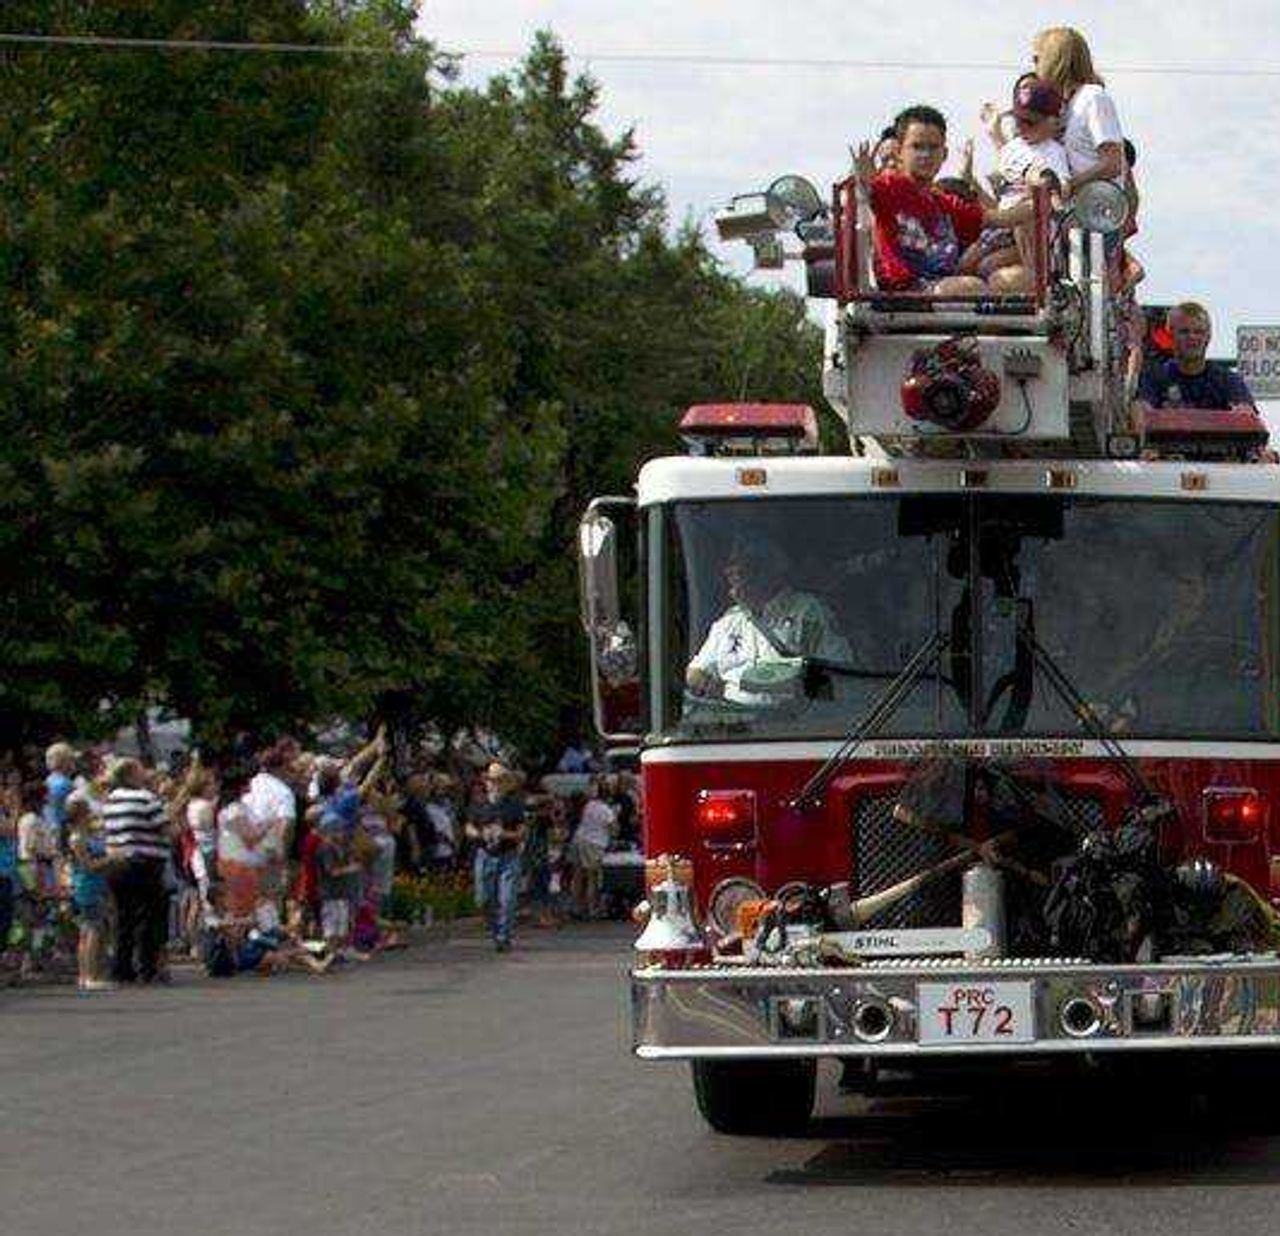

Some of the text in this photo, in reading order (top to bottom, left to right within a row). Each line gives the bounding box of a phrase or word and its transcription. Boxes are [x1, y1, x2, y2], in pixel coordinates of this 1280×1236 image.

[1239, 335, 1259, 351] DO
[854, 936, 898, 949] STIHL
[953, 988, 995, 1006] PRC
